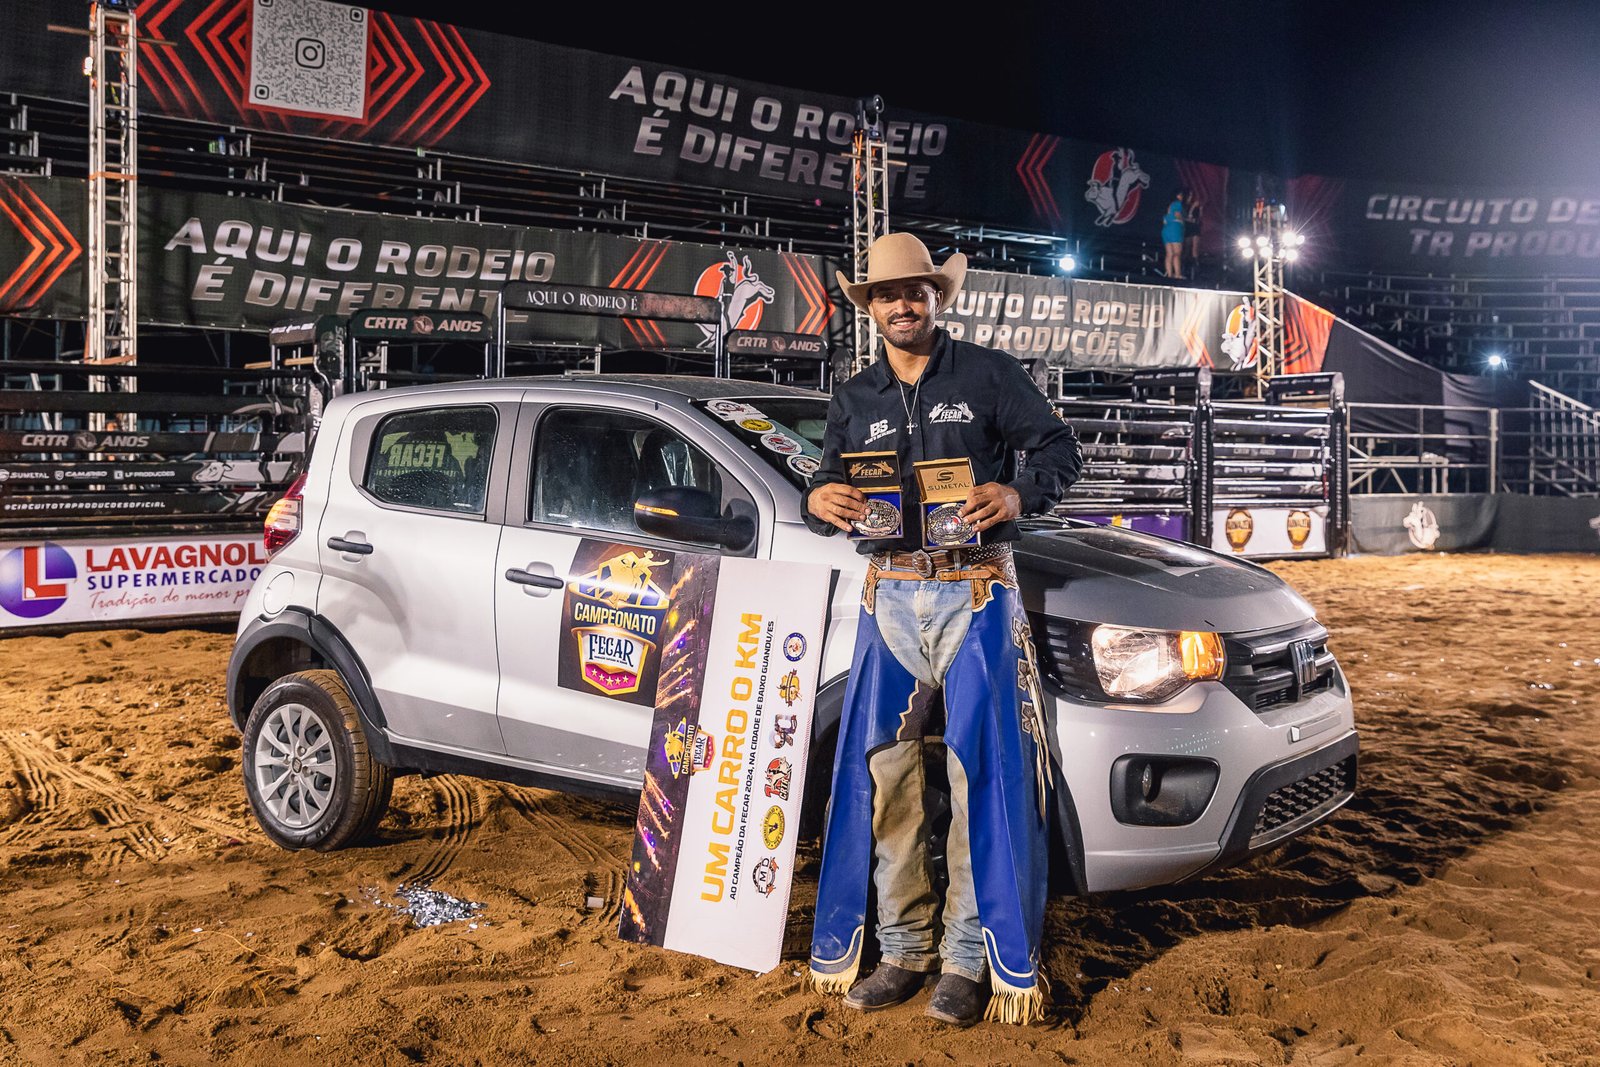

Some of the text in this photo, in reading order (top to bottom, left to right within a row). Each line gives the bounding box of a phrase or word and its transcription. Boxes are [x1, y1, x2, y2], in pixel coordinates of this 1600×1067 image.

[609, 66, 947, 156] AQUI O ROEIO
[634, 110, 930, 198] É DIFERETE
[1365, 193, 1538, 224] CIRCUITO
[164, 217, 556, 282] AQUI O RODEIO
[1409, 228, 1454, 257] TR
[191, 256, 234, 301] É
[526, 291, 557, 305] AQUI
[562, 292, 574, 305] O
[580, 293, 626, 310] RODEIO
[631, 296, 637, 310] É
[1031, 294, 1068, 320] DE
[1074, 299, 1164, 328] RODEIO
[364, 316, 483, 332] CRTR ANOS
[736, 336, 821, 352] CRTR ANOS
[975, 324, 1137, 358] PRODUÇÕES
[870, 419, 889, 438] BS
[941, 411, 962, 419] FECAR
[21, 434, 150, 447] CRTR ANOS
[9, 471, 50, 479] SUMETAL
[927, 482, 970, 491] SUMETAL
[86, 543, 269, 572] LAVAGNOL
[87, 568, 262, 590] SUPERMERCADO
[89, 591, 157, 609] Tradição
[163, 588, 180, 602] do
[186, 590, 231, 602] menor
[574, 602, 656, 636] CAMPEONATO
[589, 634, 634, 667] FECAR
[735, 613, 763, 669] KM
[681, 724, 695, 775] CAMPEONATO
[693, 737, 706, 765] FECAR
[730, 620, 774, 900] AO CAMPEÃO DA FECAR 2024, NA CIDADE DE BAIXO GUANDU/ES
[712, 709, 748, 835] CARRO
[701, 842, 730, 903] UM
